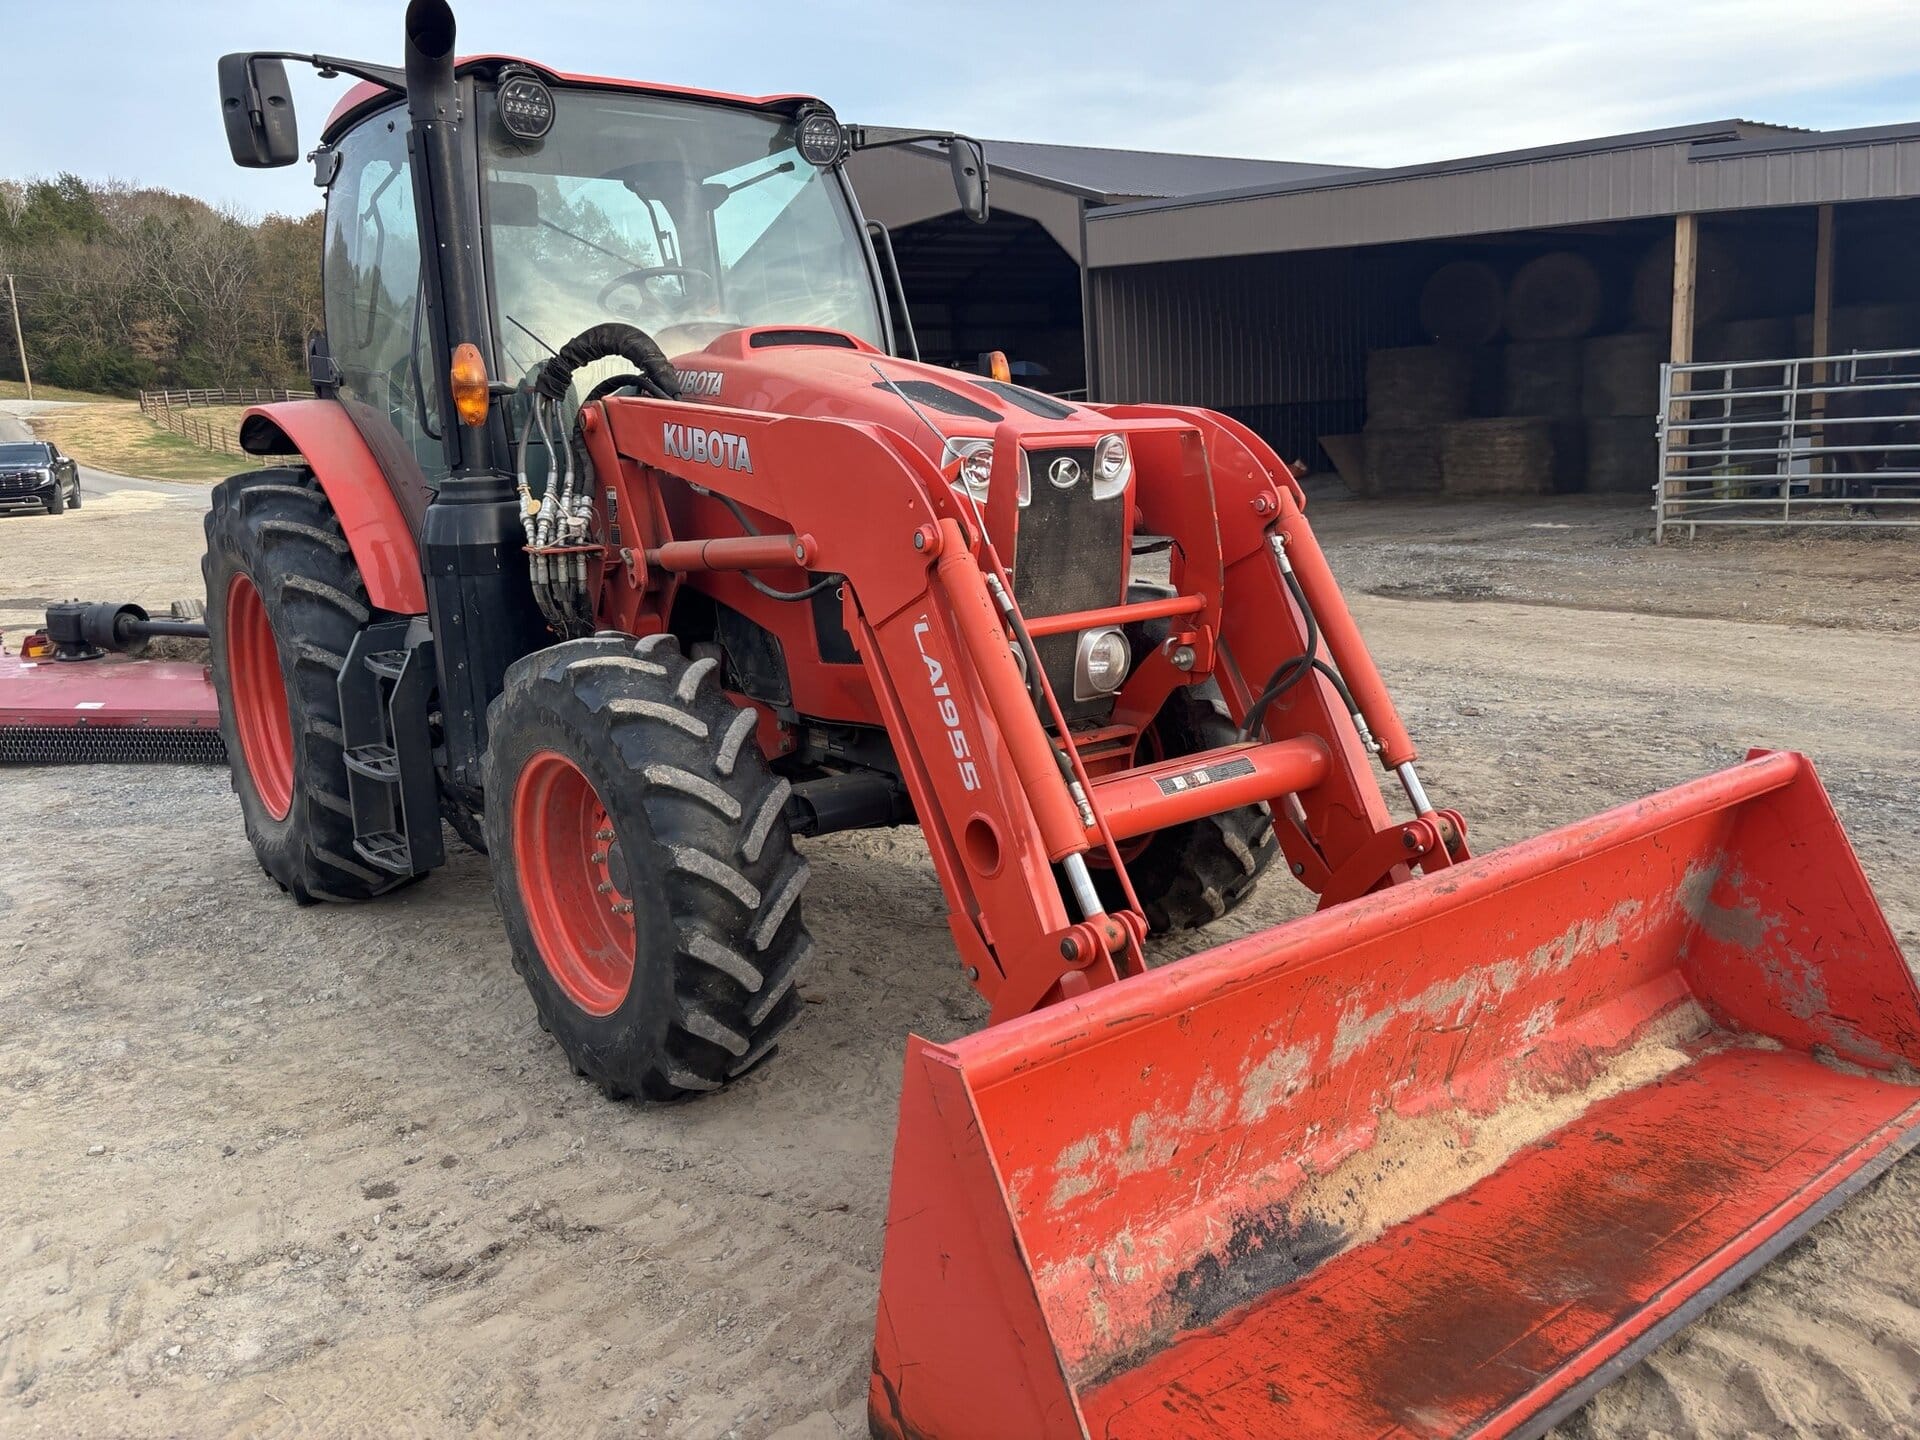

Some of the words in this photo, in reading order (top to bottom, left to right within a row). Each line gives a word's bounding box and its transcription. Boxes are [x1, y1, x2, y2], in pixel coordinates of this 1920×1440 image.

[674, 369, 724, 396] UBOTA
[662, 421, 753, 474] KUBOTA
[913, 614, 982, 791] LA1955
